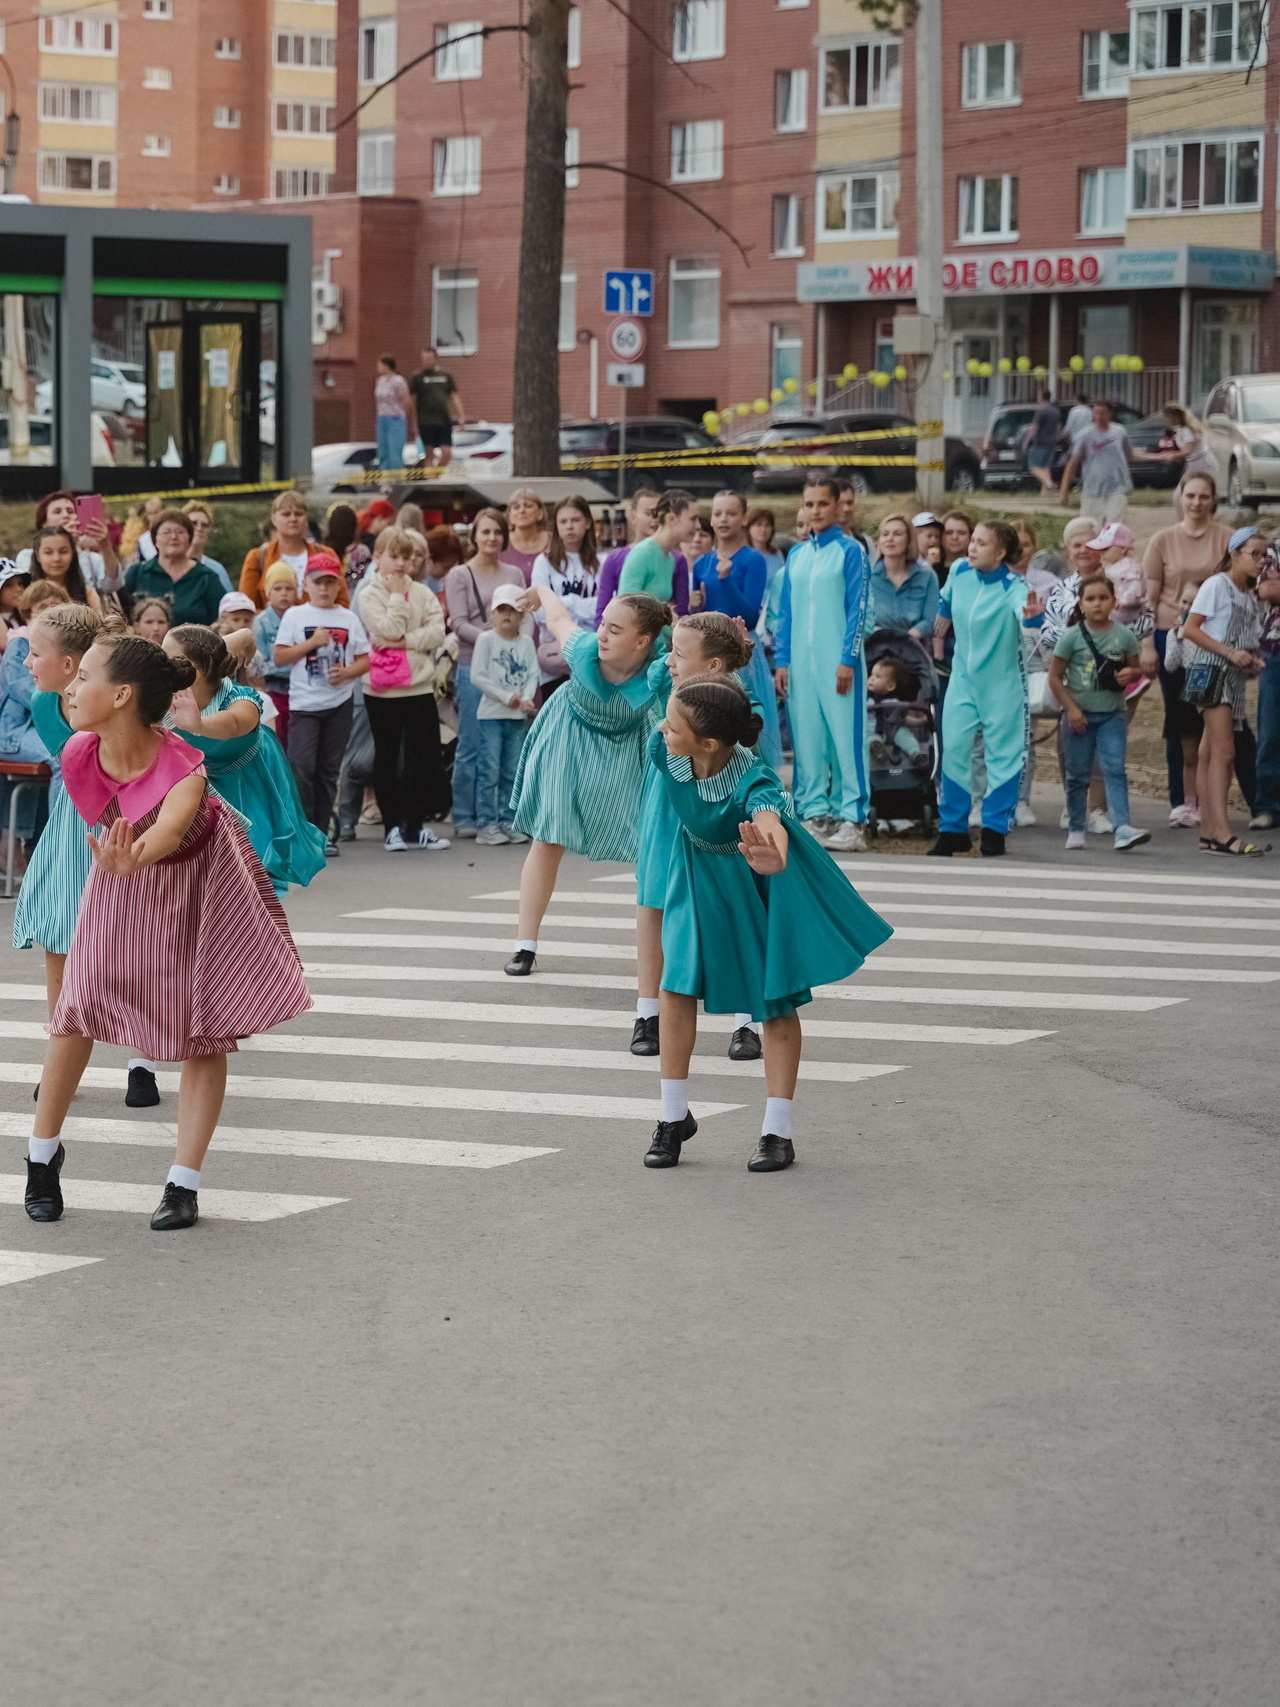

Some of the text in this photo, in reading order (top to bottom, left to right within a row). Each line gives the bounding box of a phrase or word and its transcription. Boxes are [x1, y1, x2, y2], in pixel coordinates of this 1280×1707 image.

[867, 262, 977, 292] ЖИОЕ
[990, 256, 1099, 286] СЛОВО
[616, 331, 637, 348] 60
